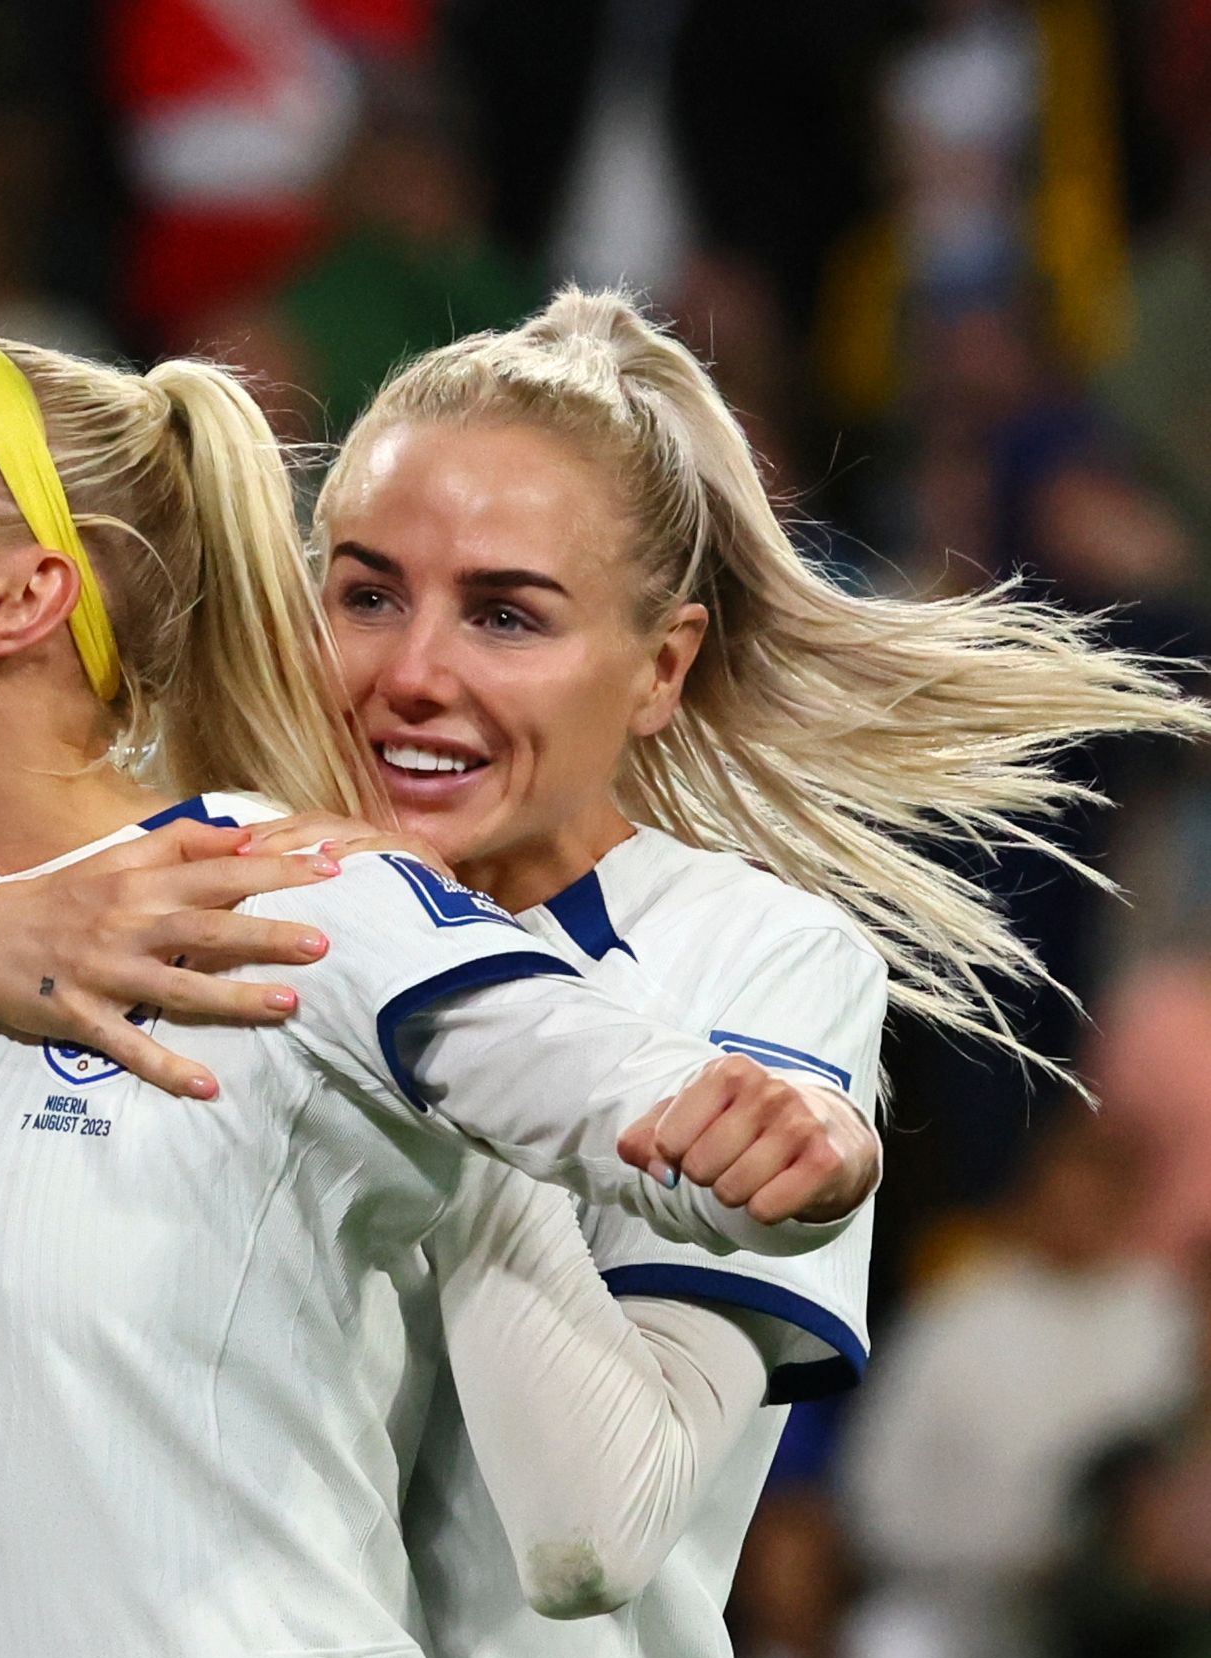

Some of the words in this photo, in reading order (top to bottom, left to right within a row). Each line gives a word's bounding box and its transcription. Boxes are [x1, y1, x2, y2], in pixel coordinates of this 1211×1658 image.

[44, 1095, 88, 1115] NIGERIA
[20, 1113, 32, 1130] 7
[32, 1113, 79, 1133] AUGUST
[80, 1118, 111, 1137] 2023
